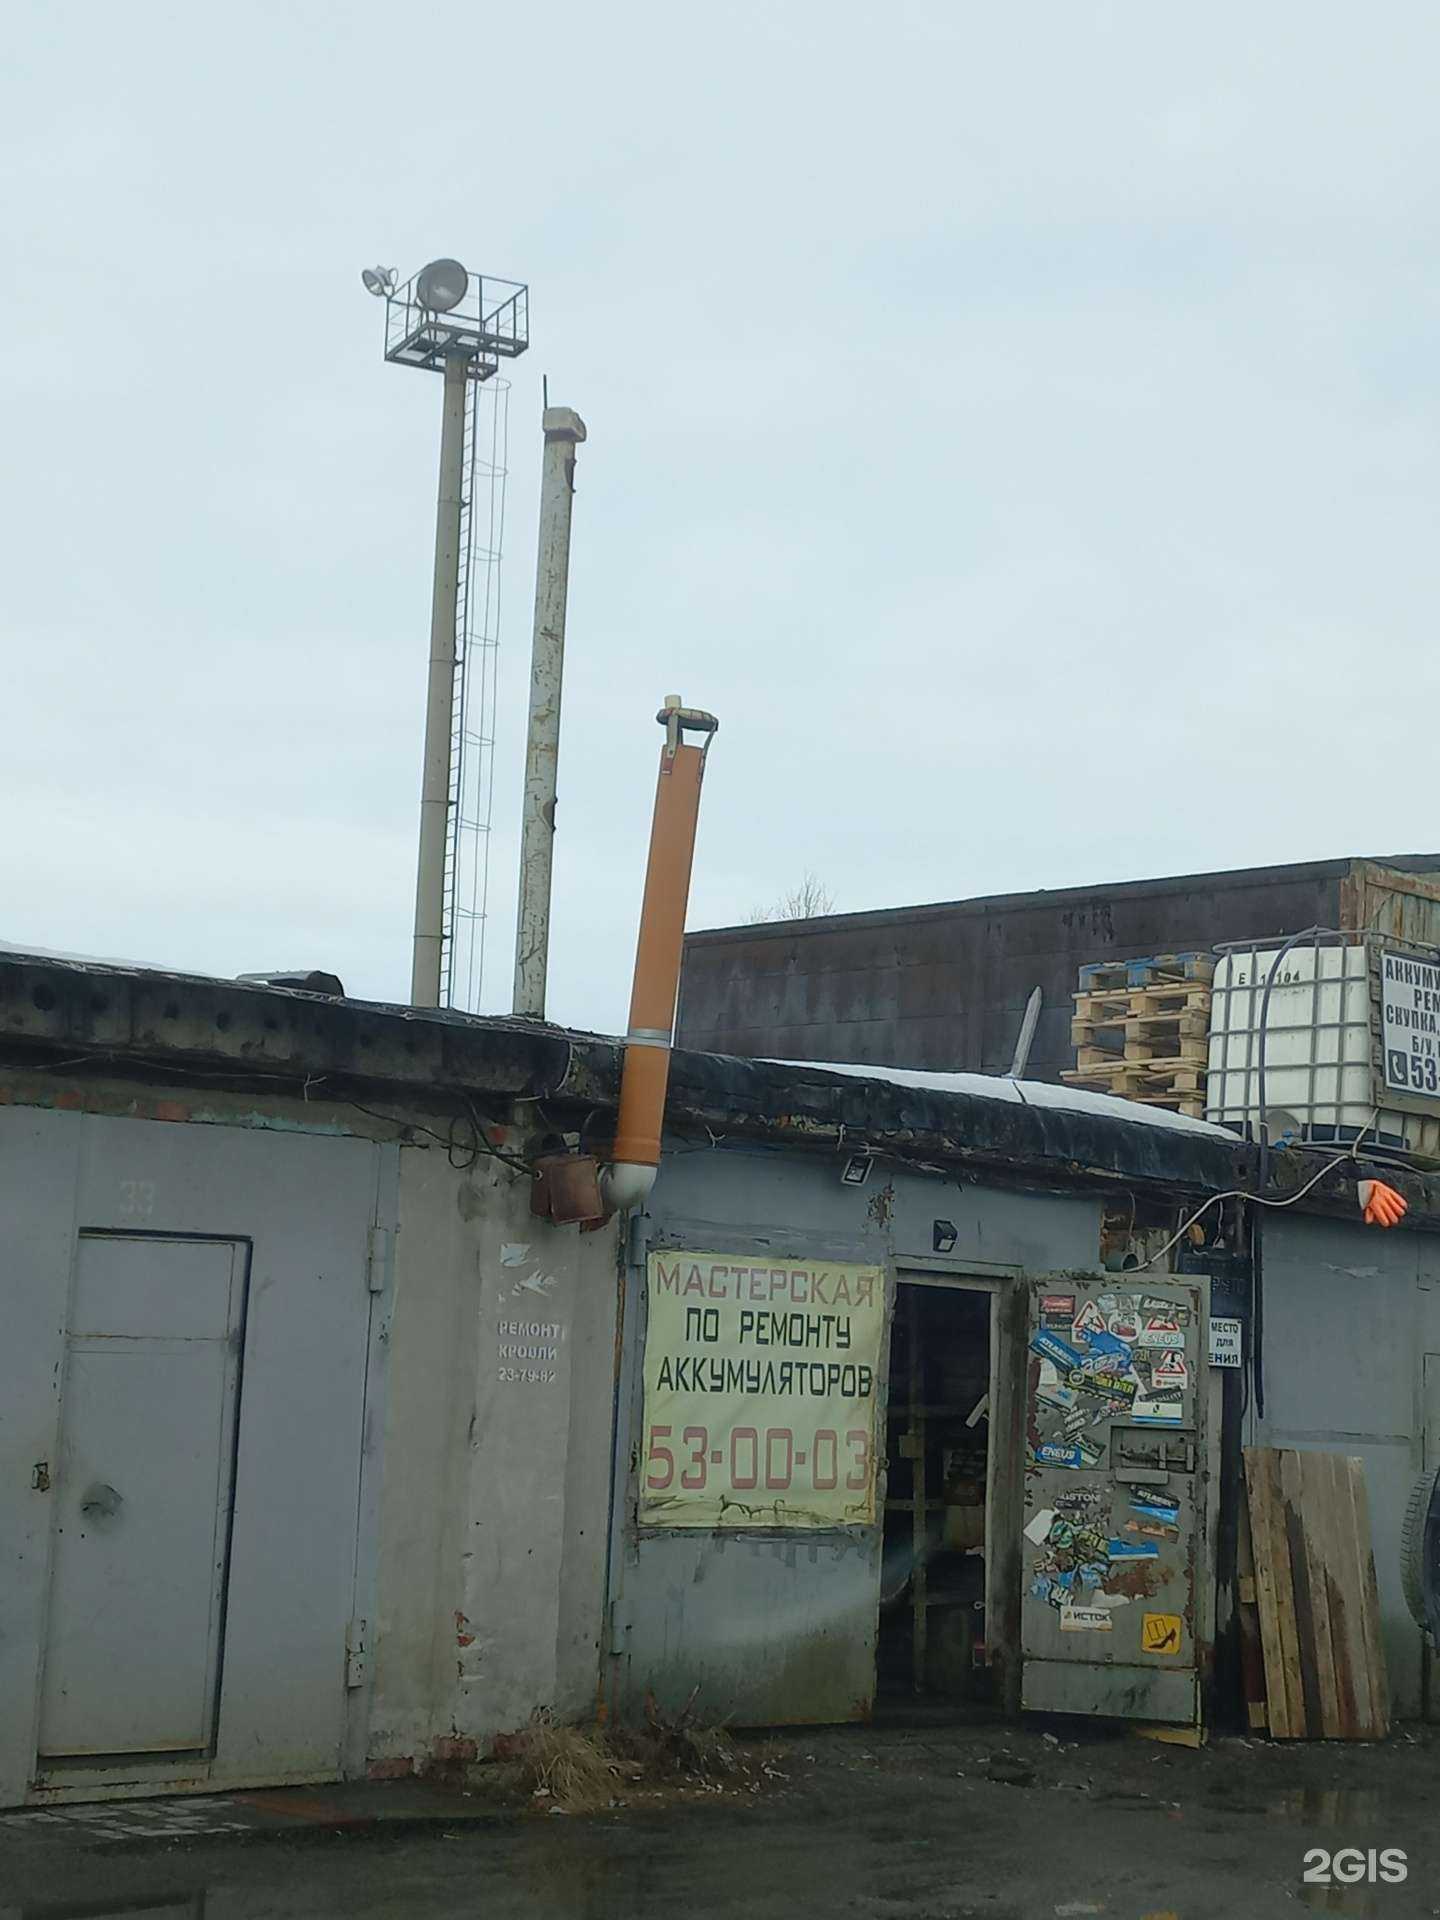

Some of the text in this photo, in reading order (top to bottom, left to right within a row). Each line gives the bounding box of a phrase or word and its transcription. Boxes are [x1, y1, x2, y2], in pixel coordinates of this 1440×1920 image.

[656, 1261, 876, 1308] МАСТЕРСКАЯ
[499, 1321, 560, 1339] РЕМОНТ
[686, 1307, 851, 1349] ПО РЕМОНТУ
[1211, 1321, 1239, 1334] МЕСТО
[1216, 1337, 1234, 1348] ДЛЯ
[656, 1355, 874, 1398] АККУМУЛЯТОРОВ
[647, 1425, 870, 1490] 53-00-03
